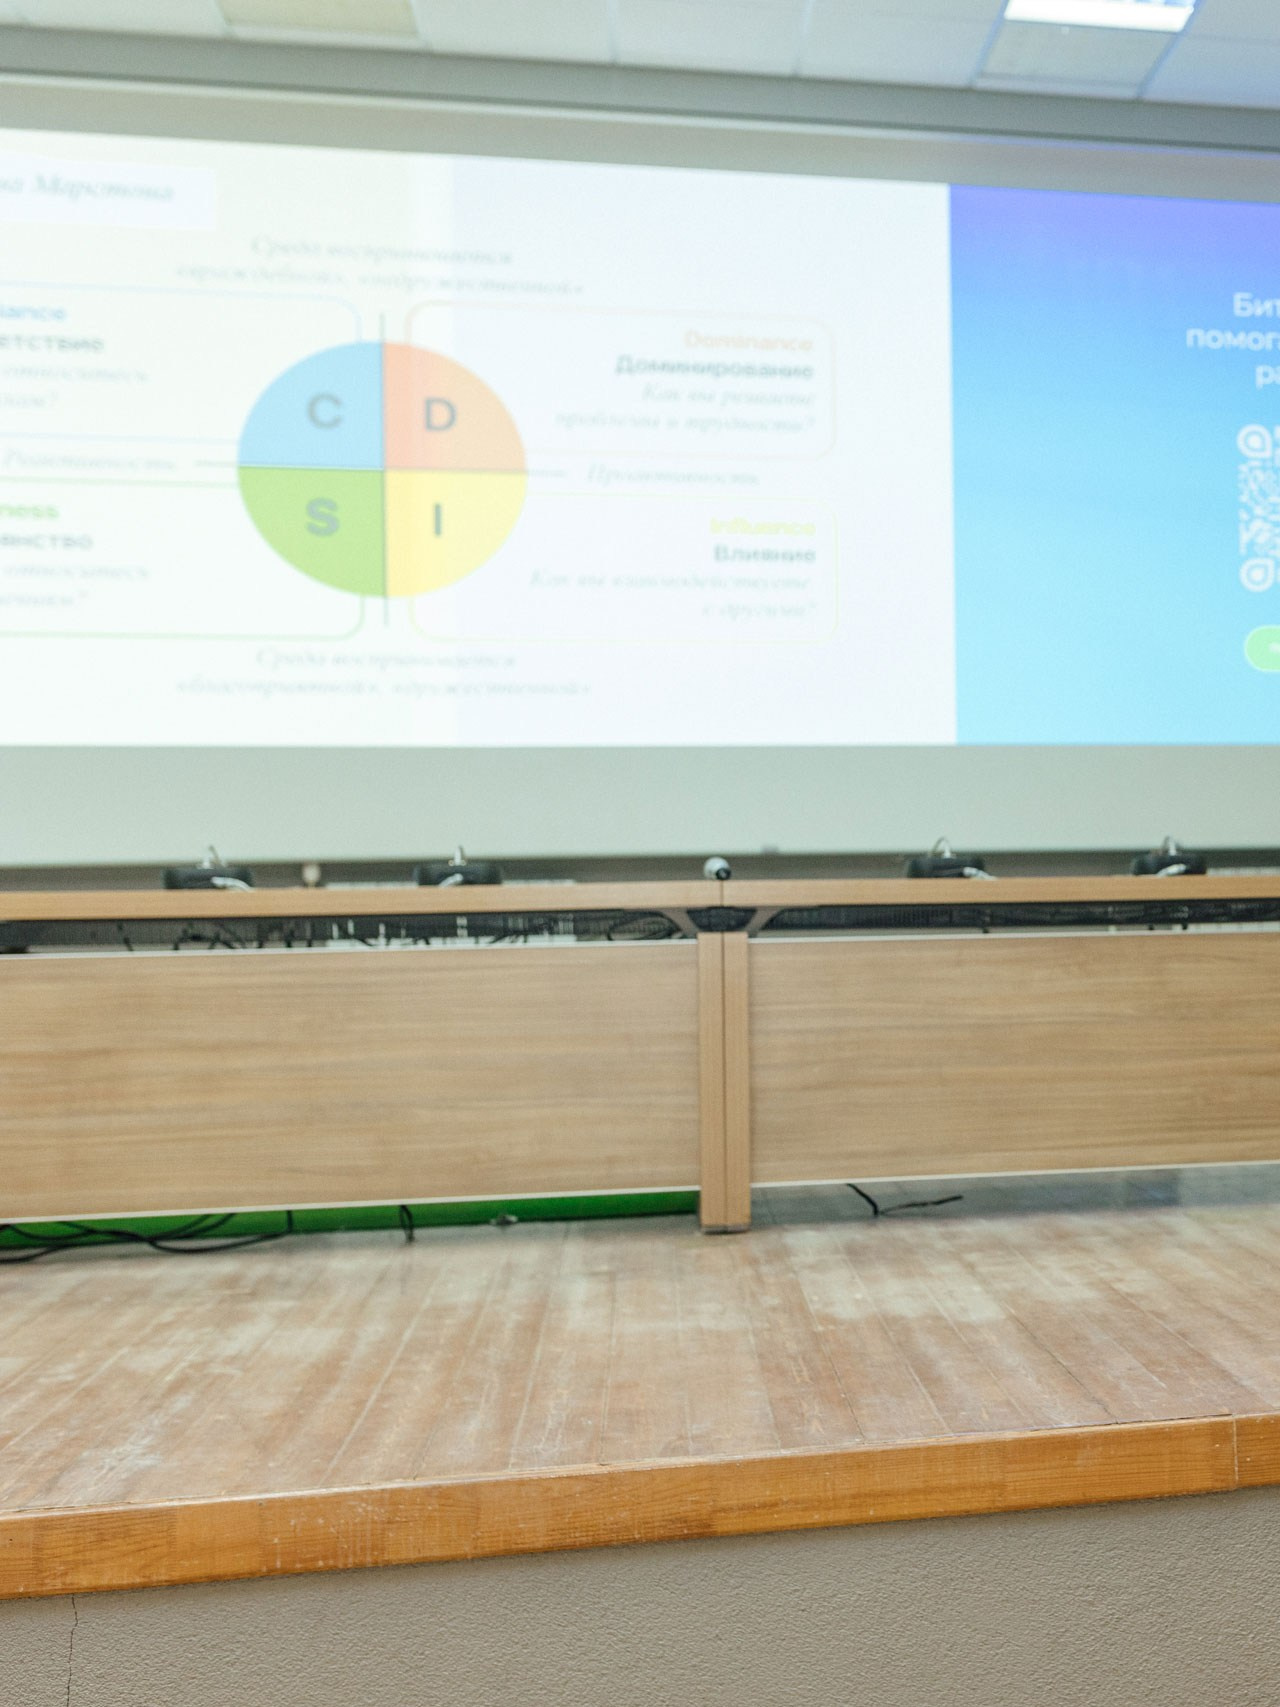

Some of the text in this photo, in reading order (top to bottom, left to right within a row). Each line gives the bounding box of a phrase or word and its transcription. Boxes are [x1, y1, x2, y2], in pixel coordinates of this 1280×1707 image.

[684, 329, 814, 353] Dominance
[614, 353, 815, 380] Доминирование
[306, 392, 344, 431] C
[423, 396, 458, 432] D
[305, 497, 341, 538] S
[708, 517, 816, 537] Influence
[711, 542, 816, 564] Влияние
